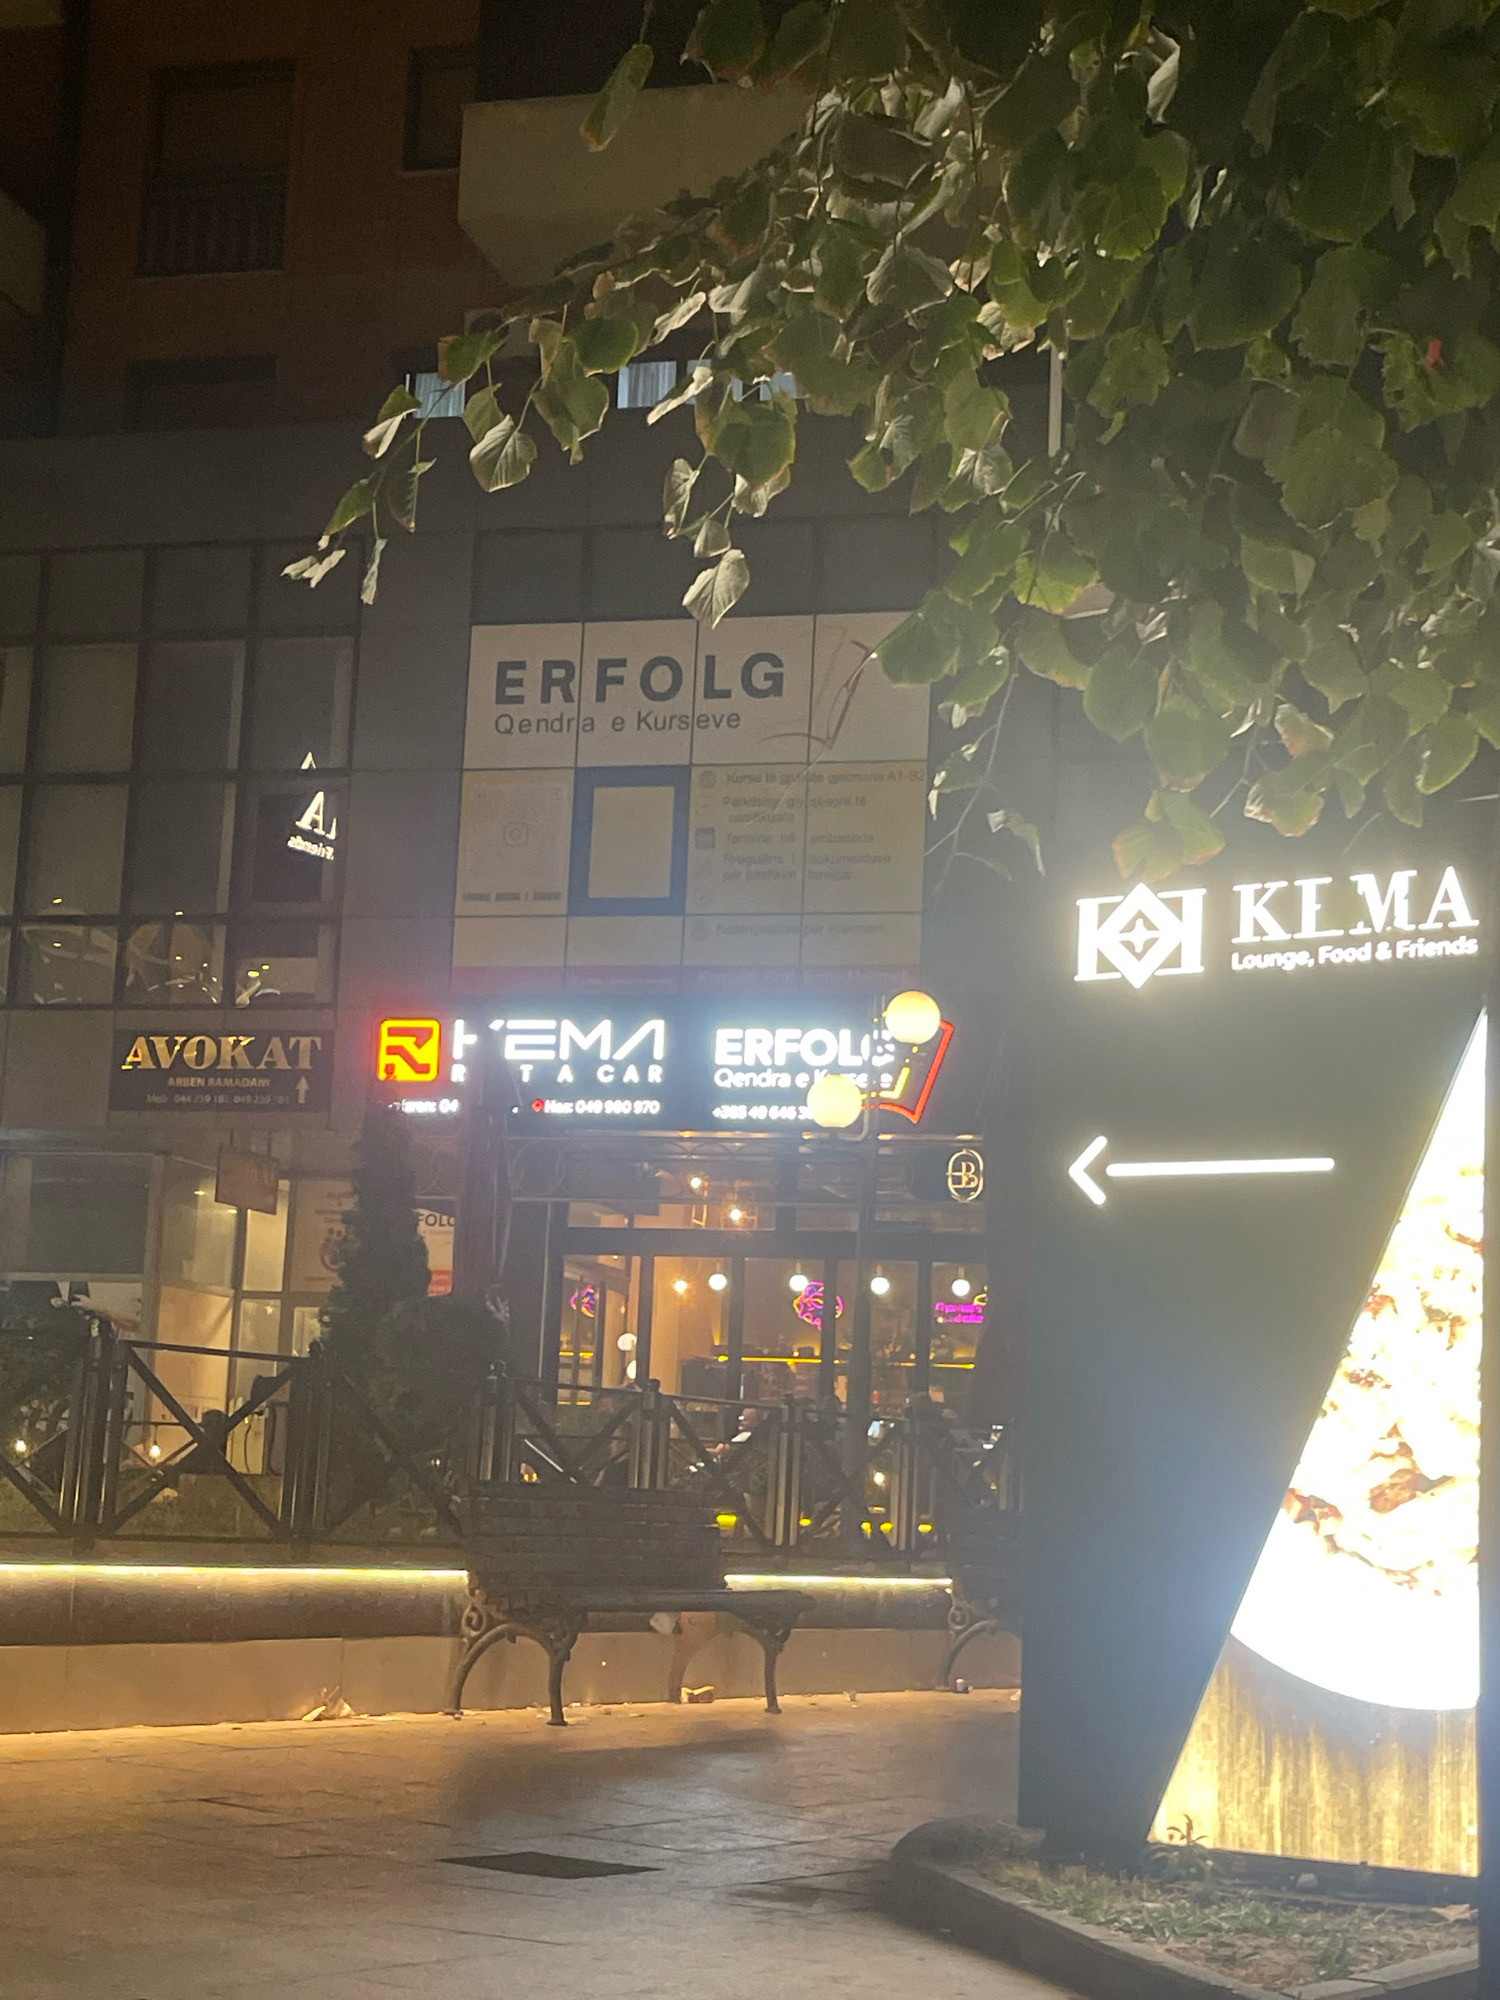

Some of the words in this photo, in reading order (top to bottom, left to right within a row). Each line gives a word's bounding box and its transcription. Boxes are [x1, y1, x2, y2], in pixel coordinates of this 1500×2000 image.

[495, 653, 785, 705] ERFOLG
[495, 713, 595, 735] Qendra
[611, 716, 626, 732] e
[637, 710, 741, 732] Kurseve
[1231, 866, 1480, 944] KEMA
[1231, 950, 1315, 971] Lounge,
[1318, 942, 1372, 964] Food
[1375, 941, 1392, 960] &
[1395, 936, 1479, 959] Friends
[121, 1035, 322, 1070] AVOKAT
[596, 1064, 663, 1083] CAR
[713, 1067, 792, 1089] Qendra
[795, 1072, 810, 1089] e
